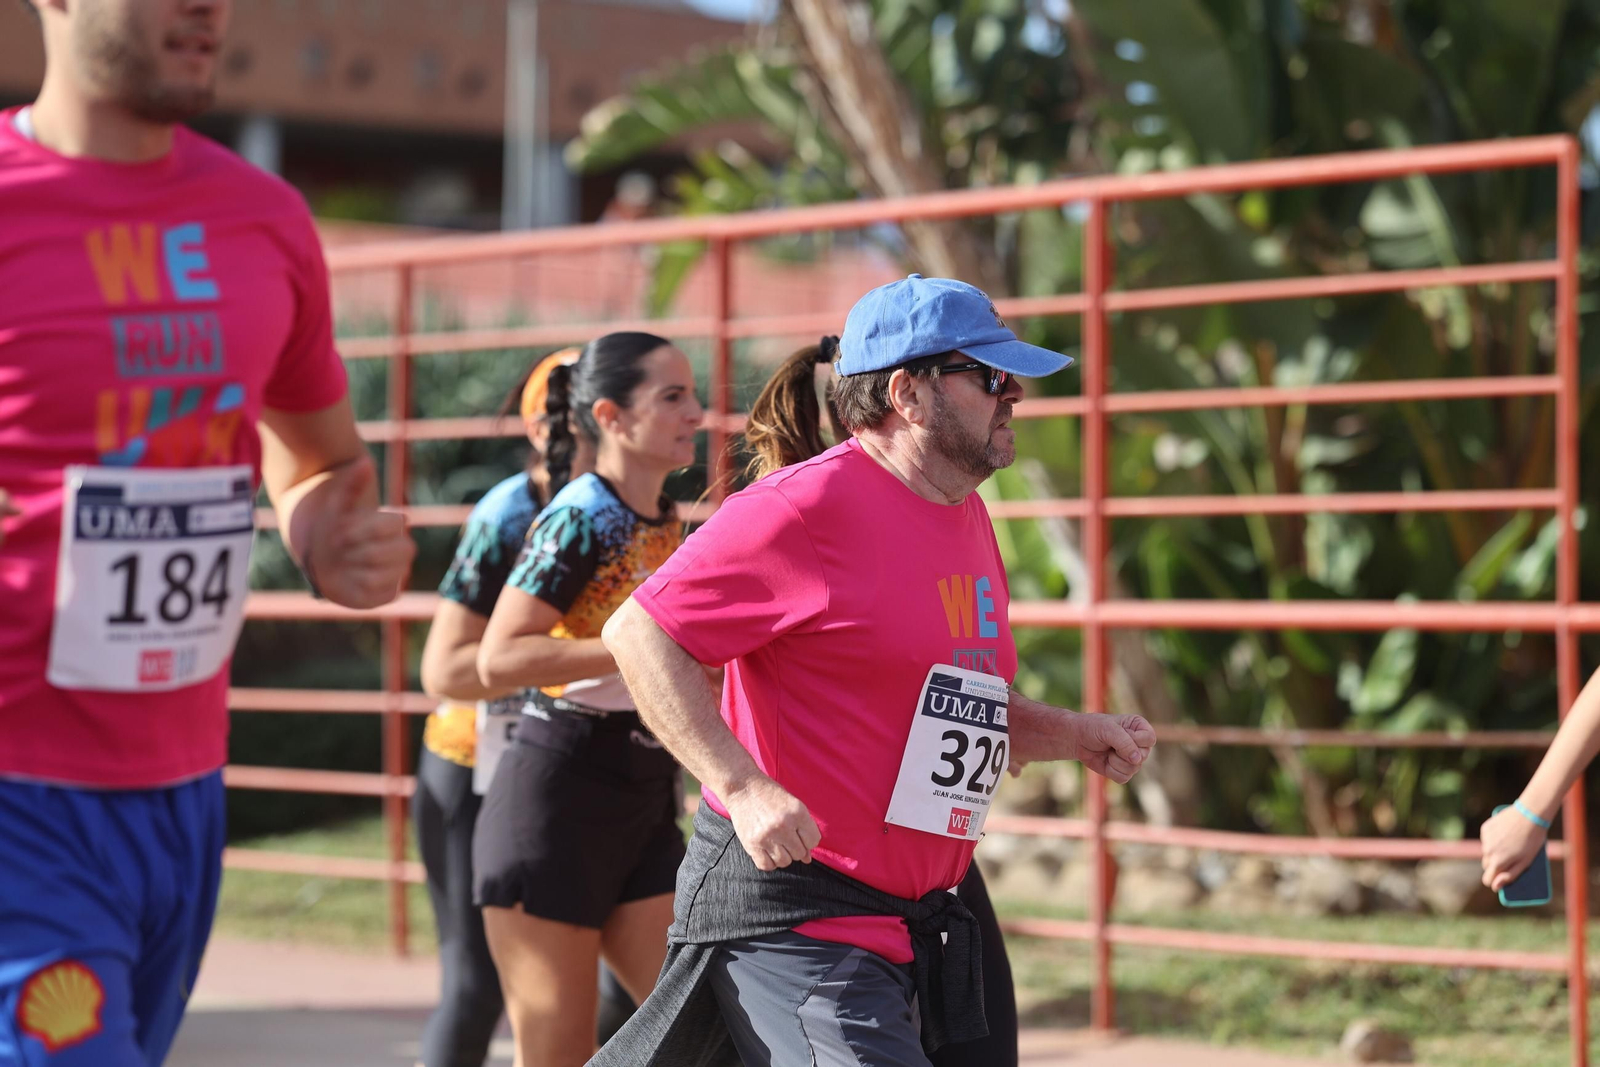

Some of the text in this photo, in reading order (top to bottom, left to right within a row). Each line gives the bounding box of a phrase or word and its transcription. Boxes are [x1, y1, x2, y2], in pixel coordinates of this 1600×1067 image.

[86, 223, 220, 303] WE
[122, 318, 218, 372] RUN
[79, 506, 178, 537] UMA
[107, 547, 231, 625] 184
[936, 574, 999, 638] WE
[930, 691, 988, 724] UMA
[931, 729, 1006, 796] 329
[932, 789, 950, 798] JUAN
[949, 792, 964, 802] JOSE
[950, 813, 971, 830] WE
